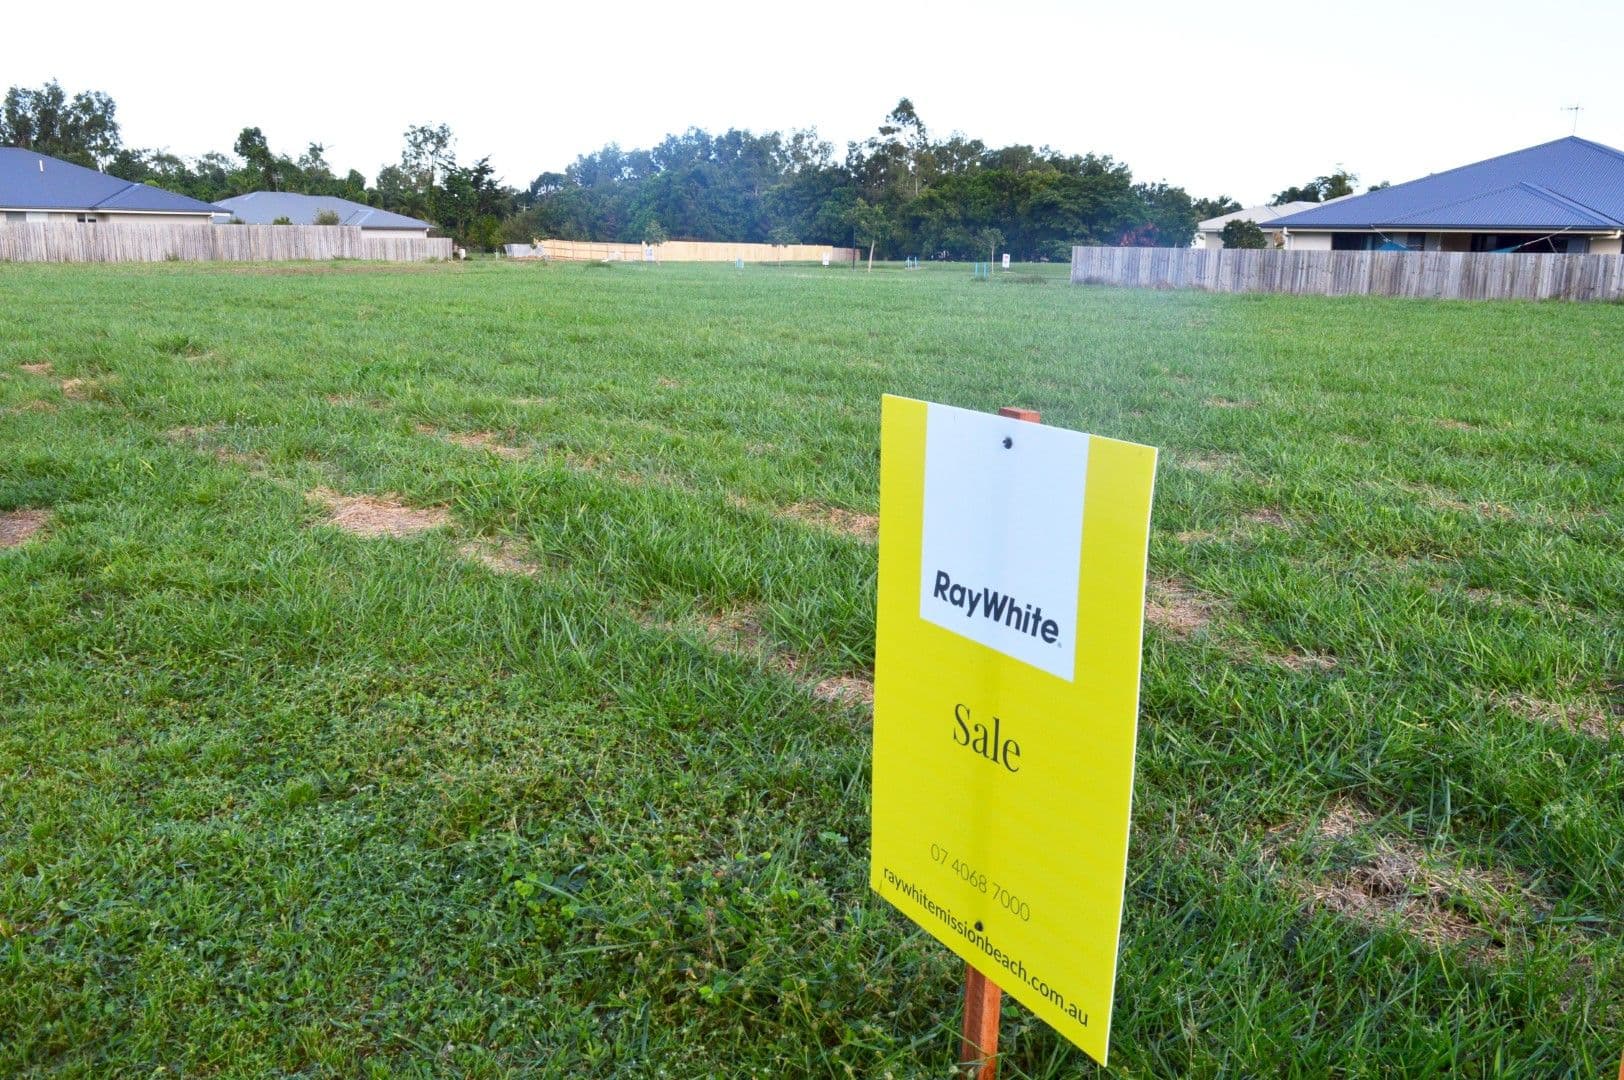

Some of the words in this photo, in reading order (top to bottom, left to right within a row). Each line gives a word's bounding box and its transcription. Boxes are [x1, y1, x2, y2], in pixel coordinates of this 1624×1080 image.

[933, 570, 1059, 644] RayWhite
[953, 703, 1021, 773] Sale
[930, 843, 948, 865] 07
[951, 858, 987, 894] 4068
[992, 882, 1031, 922] 7000
[883, 867, 1089, 1028] raywhitemissionbeach.com.au
